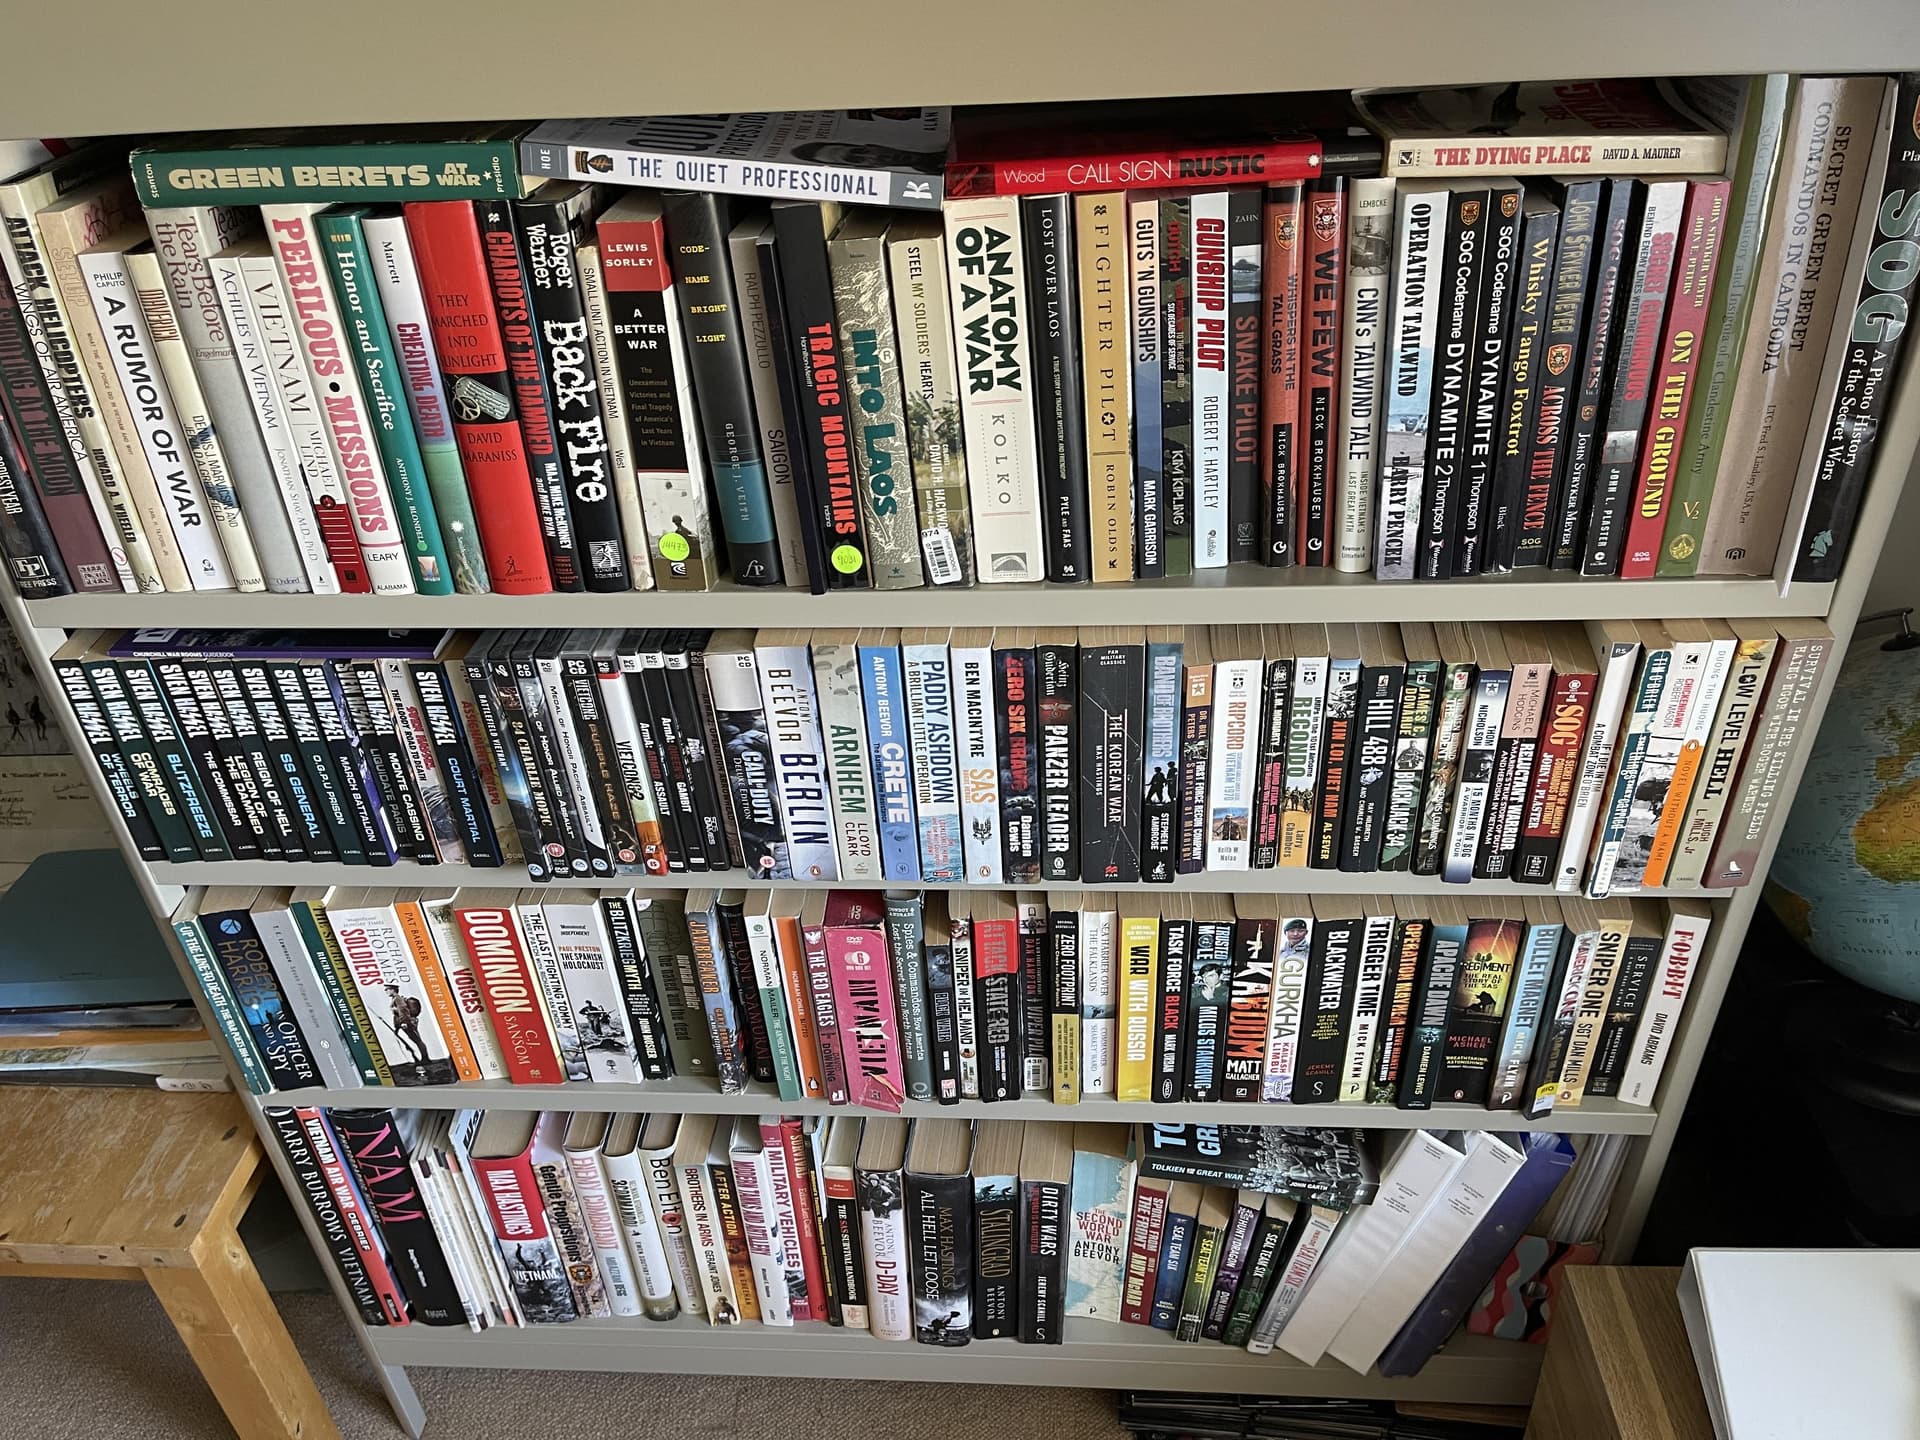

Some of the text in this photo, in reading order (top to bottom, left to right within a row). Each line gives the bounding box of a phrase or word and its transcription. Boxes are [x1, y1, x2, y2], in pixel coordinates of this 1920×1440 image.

[146, 163, 160, 198] Stanton
[168, 163, 481, 190] GREEN BERETS AT WAR
[492, 156, 505, 194] presidio
[540, 148, 550, 170] HOE
[627, 156, 878, 196] THE QUIET PROFESSIONAL
[1004, 168, 1045, 183] Wood
[1067, 153, 1264, 184] CALL SIGN RUSTIC
[1435, 145, 1591, 165] THE DYING PLACE
[1602, 147, 1681, 160] DAVID A. MAURER
[1360, 200, 1387, 208] LEMBCKE
[1789, 125, 1853, 352] SECRET GREEN BERET
[94, 272, 122, 281] PHILIP
[96, 280, 125, 288] CAPUTO
[155, 223, 192, 309] the Rain
[174, 216, 224, 343] Tears Before
[526, 223, 551, 289] Warner
[550, 232, 573, 288] Roger
[606, 258, 653, 266] SORLEY
[608, 243, 648, 252] LEWIS
[615, 323, 666, 334] BETTER
[955, 226, 992, 396] OF A WAR
[984, 225, 1021, 391] ANATOMY
[1196, 219, 1226, 371] GUNSHIP PILOT
[1312, 252, 1338, 377] WE FEW
[1400, 203, 1430, 397] OPERATION TAILWIND
[1761, 271, 1797, 374] CAMBODIA
[627, 339, 657, 350] WAR
[1093, 224, 1116, 442] FIGHTER PILOT
[1506, 238, 1550, 456] Whisky Tango Foxtrot
[103, 296, 201, 527] A RUMOR OF WAR
[271, 217, 388, 533] PERILOUS MISSIONS
[544, 317, 608, 503] Back Fire
[1432, 230, 1475, 534] SOG Codename DYNAMITE 2 Thompson
[808, 322, 856, 535] TRAGIC MOUNTAINS
[851, 329, 898, 516] INTO LAOS
[1641, 330, 1694, 518] ON THE GROUND
[991, 415, 1009, 506] KOLKO
[367, 553, 399, 562] LEARY
[376, 583, 407, 591] ALABAMA
[768, 669, 801, 742] BEEVOR
[873, 657, 892, 737] ANTONY BEEVOR
[922, 660, 954, 803] PADDY ASHDOWN
[965, 662, 984, 757] BEN MACINTYRE
[1361, 699, 1394, 766] HILL 488
[1551, 705, 1584, 745] SOG
[1704, 665, 1761, 799] LOW LEVEL HELL
[830, 725, 866, 813] ARNHEM
[1287, 697, 1312, 778] RECONDO
[167, 754, 214, 839] BLITZFREEZE
[448, 757, 481, 843] COURT MARTIAL
[780, 754, 829, 844] BERLIN
[881, 743, 910, 823] CRETE
[1044, 724, 1069, 853] PANZER LEADER
[845, 822, 858, 856] CLARK
[857, 823, 870, 856] LLOYD
[1701, 822, 1713, 842] HUGH
[340, 929, 384, 986] SOLDIERS
[453, 968, 485, 1014] VOICES
[463, 911, 533, 1013] DOMINION
[563, 961, 604, 970] HOLOCAUST
[807, 950, 834, 1027] THE RED EAGLES
[1164, 926, 1184, 1030] TASK FORCE BLACK
[1318, 930, 1350, 1010] BLACKWATER
[1357, 923, 1390, 1017] TRIGGER TIME
[1422, 940, 1459, 1026] APACHE DAWN
[1126, 945, 1150, 1061] WAR WITH RUSSIA
[1272, 959, 1304, 1039] GURKHA
[503, 1016, 531, 1065] SANSOM
[1226, 1060, 1261, 1073] MATT
[344, 1122, 425, 1224] NAM
[485, 1169, 533, 1236] MAX HASTINGS
[1151, 1164, 1185, 1173] TOLKIEN
[1289, 1180, 1308, 1189] JOHN
[277, 1120, 375, 1305] LARRY BURROWS VIETNAM
[768, 1150, 801, 1268] MILITARY VEHICLES
[921, 1190, 940, 1301] ALL HELL LET LOOSE
[979, 1209, 1013, 1277] STALINGRAD
[1040, 1187, 1058, 1256] DIRTY WARS
[1076, 1212, 1122, 1229] SECOND
[1078, 1220, 1120, 1236] WORLD
[513, 1270, 556, 1282] VIETNAM
[874, 1260, 899, 1296] D-DAY
[1074, 1241, 1120, 1254] ANTONY
[1074, 1249, 1120, 1264] BEEVOR
